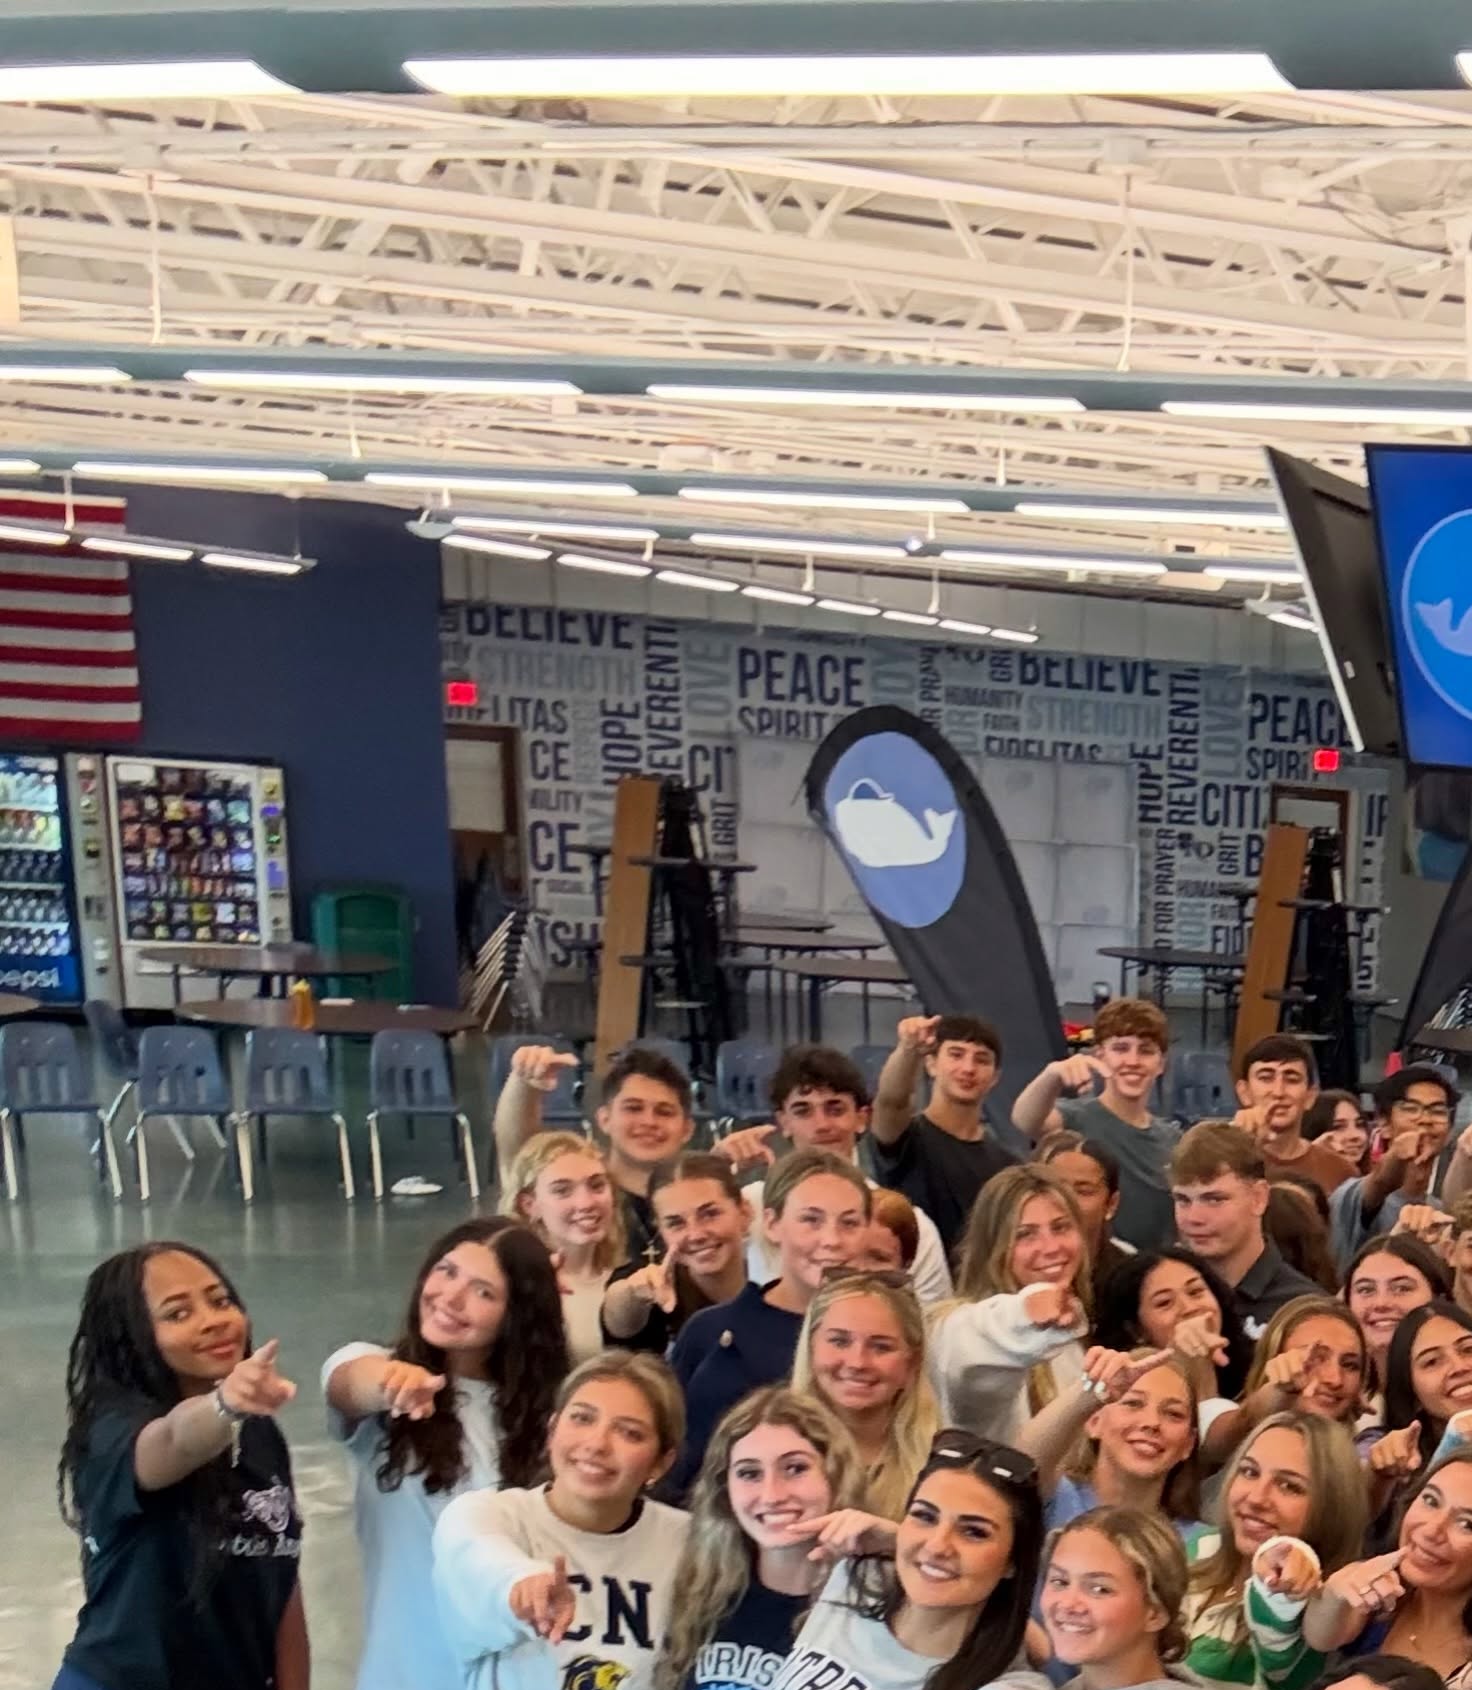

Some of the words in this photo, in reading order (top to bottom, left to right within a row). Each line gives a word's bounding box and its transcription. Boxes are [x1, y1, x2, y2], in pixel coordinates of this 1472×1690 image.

[466, 606, 633, 650] BELIEVE
[737, 646, 866, 707] PEACE
[1018, 652, 1161, 697] BELIEVE
[645, 620, 683, 787] EVERENTI
[737, 705, 829, 739] SPIRIT
[0, 967, 61, 991] epsi
[697, 1642, 784, 1690] IRIS
